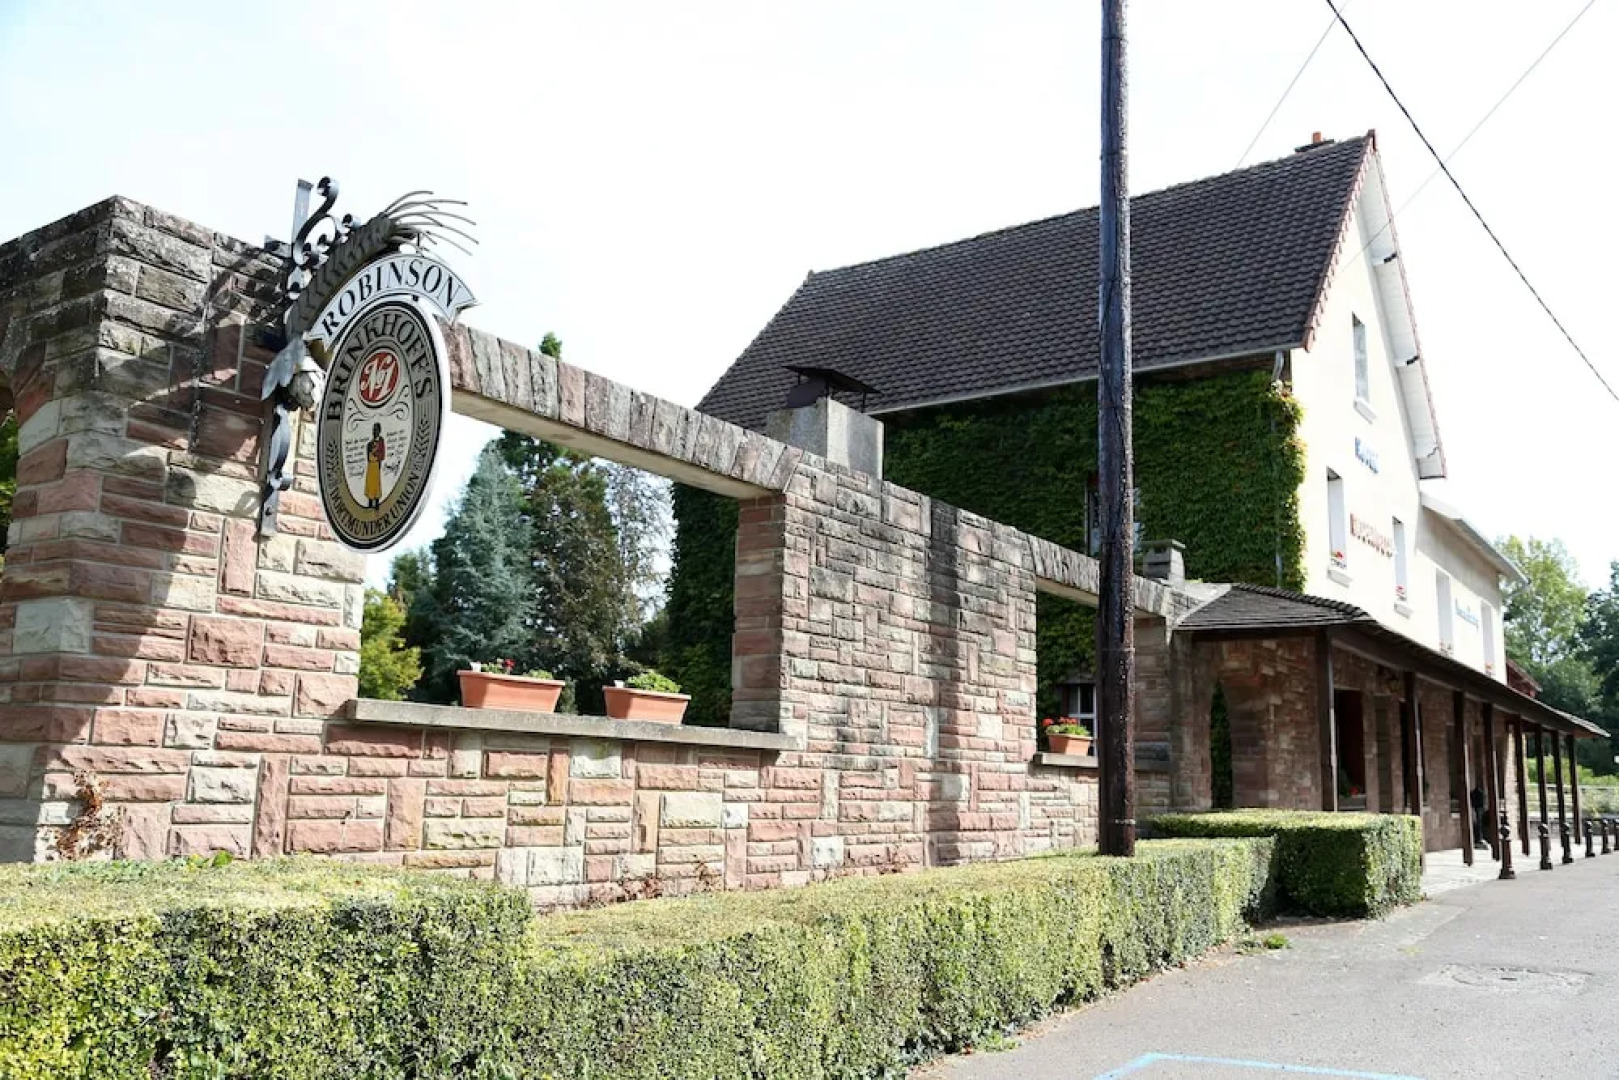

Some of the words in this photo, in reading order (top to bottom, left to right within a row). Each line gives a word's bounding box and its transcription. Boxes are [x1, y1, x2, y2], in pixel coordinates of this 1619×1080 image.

[321, 258, 462, 337] ROBINSON
[326, 313, 433, 421] BRINKHOFF'S
[329, 486, 391, 537] DORTMUNDER
[389, 472, 420, 519] UNION
